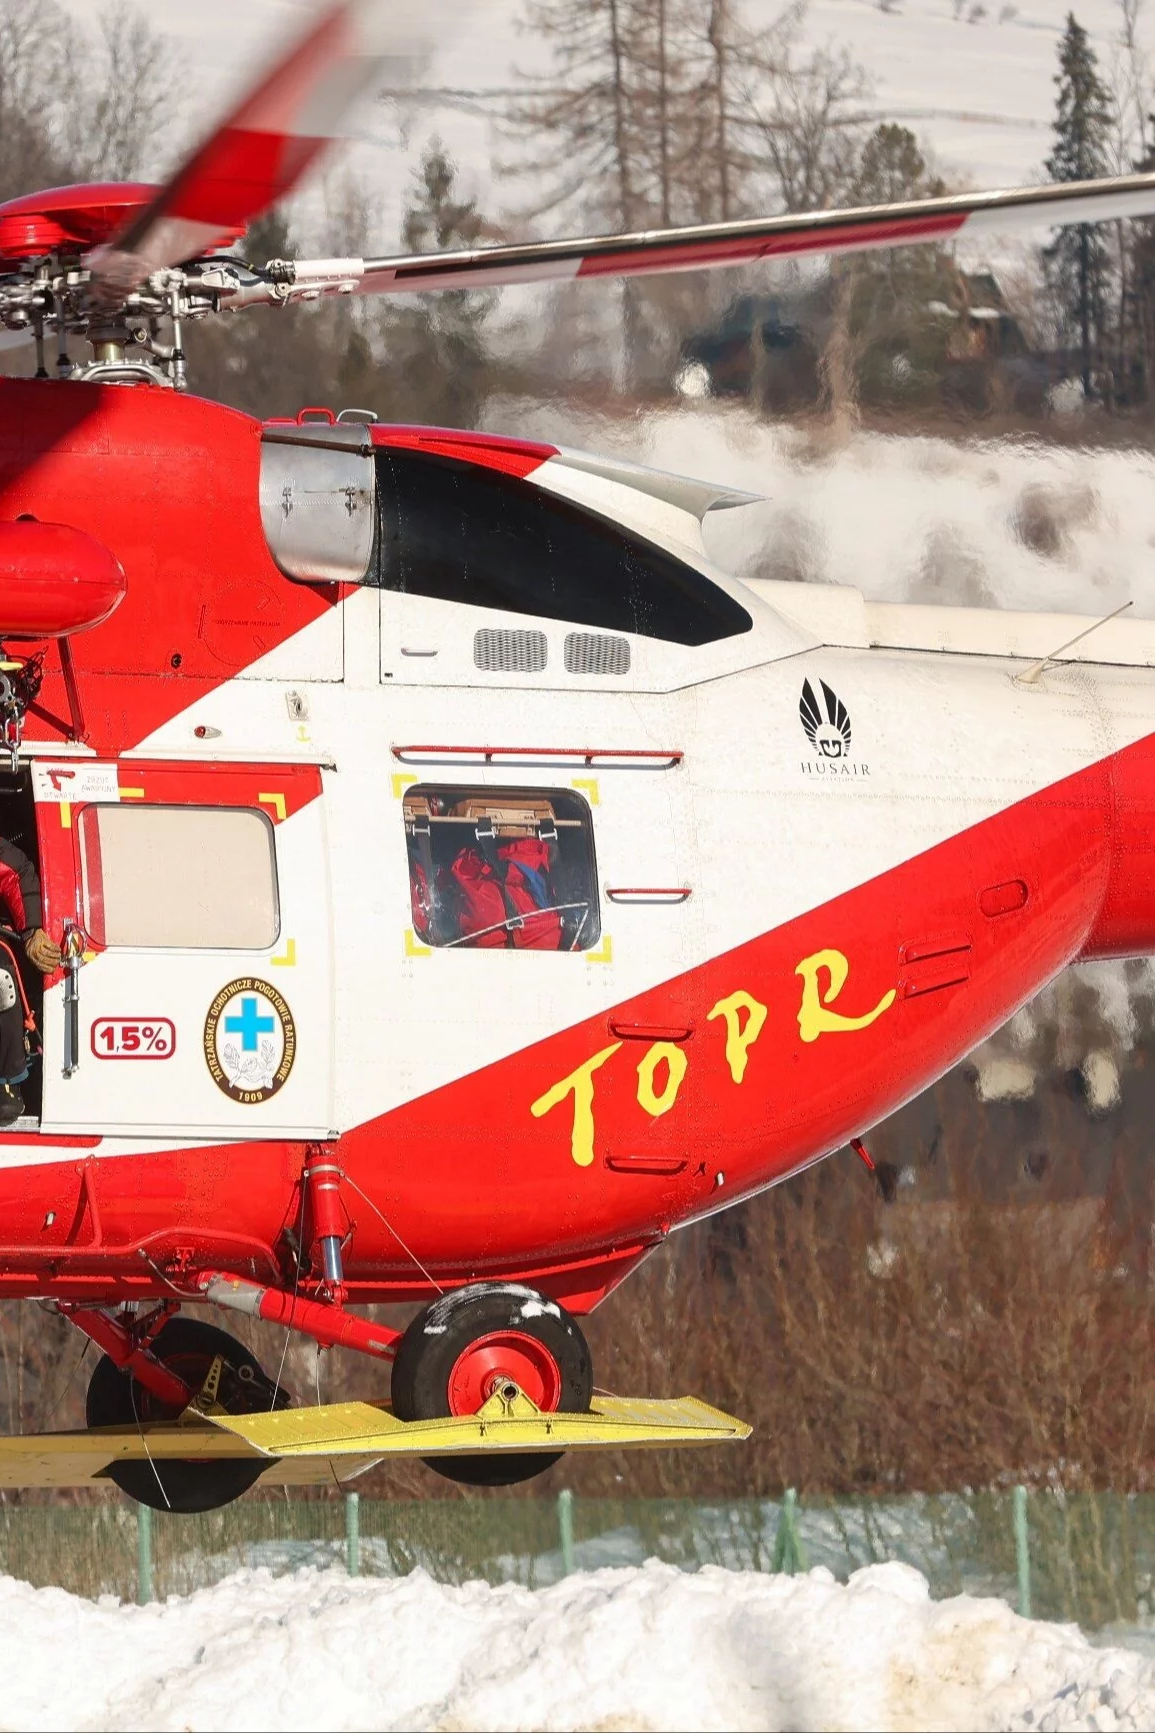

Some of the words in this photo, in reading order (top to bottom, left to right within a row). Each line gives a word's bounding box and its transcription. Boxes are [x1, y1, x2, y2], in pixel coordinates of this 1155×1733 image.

[801, 762, 870, 775] HUSAIR
[210, 979, 252, 1016] OCHOTNICZE
[254, 980, 291, 1022] POGOTOWIE
[99, 1026, 168, 1053] 1,5%
[205, 1018, 224, 1082] TATRZAŃSKIE
[276, 1024, 294, 1082] RATUNKOWE
[530, 949, 897, 1167] TOPR
[239, 1091, 263, 1102] 1909
